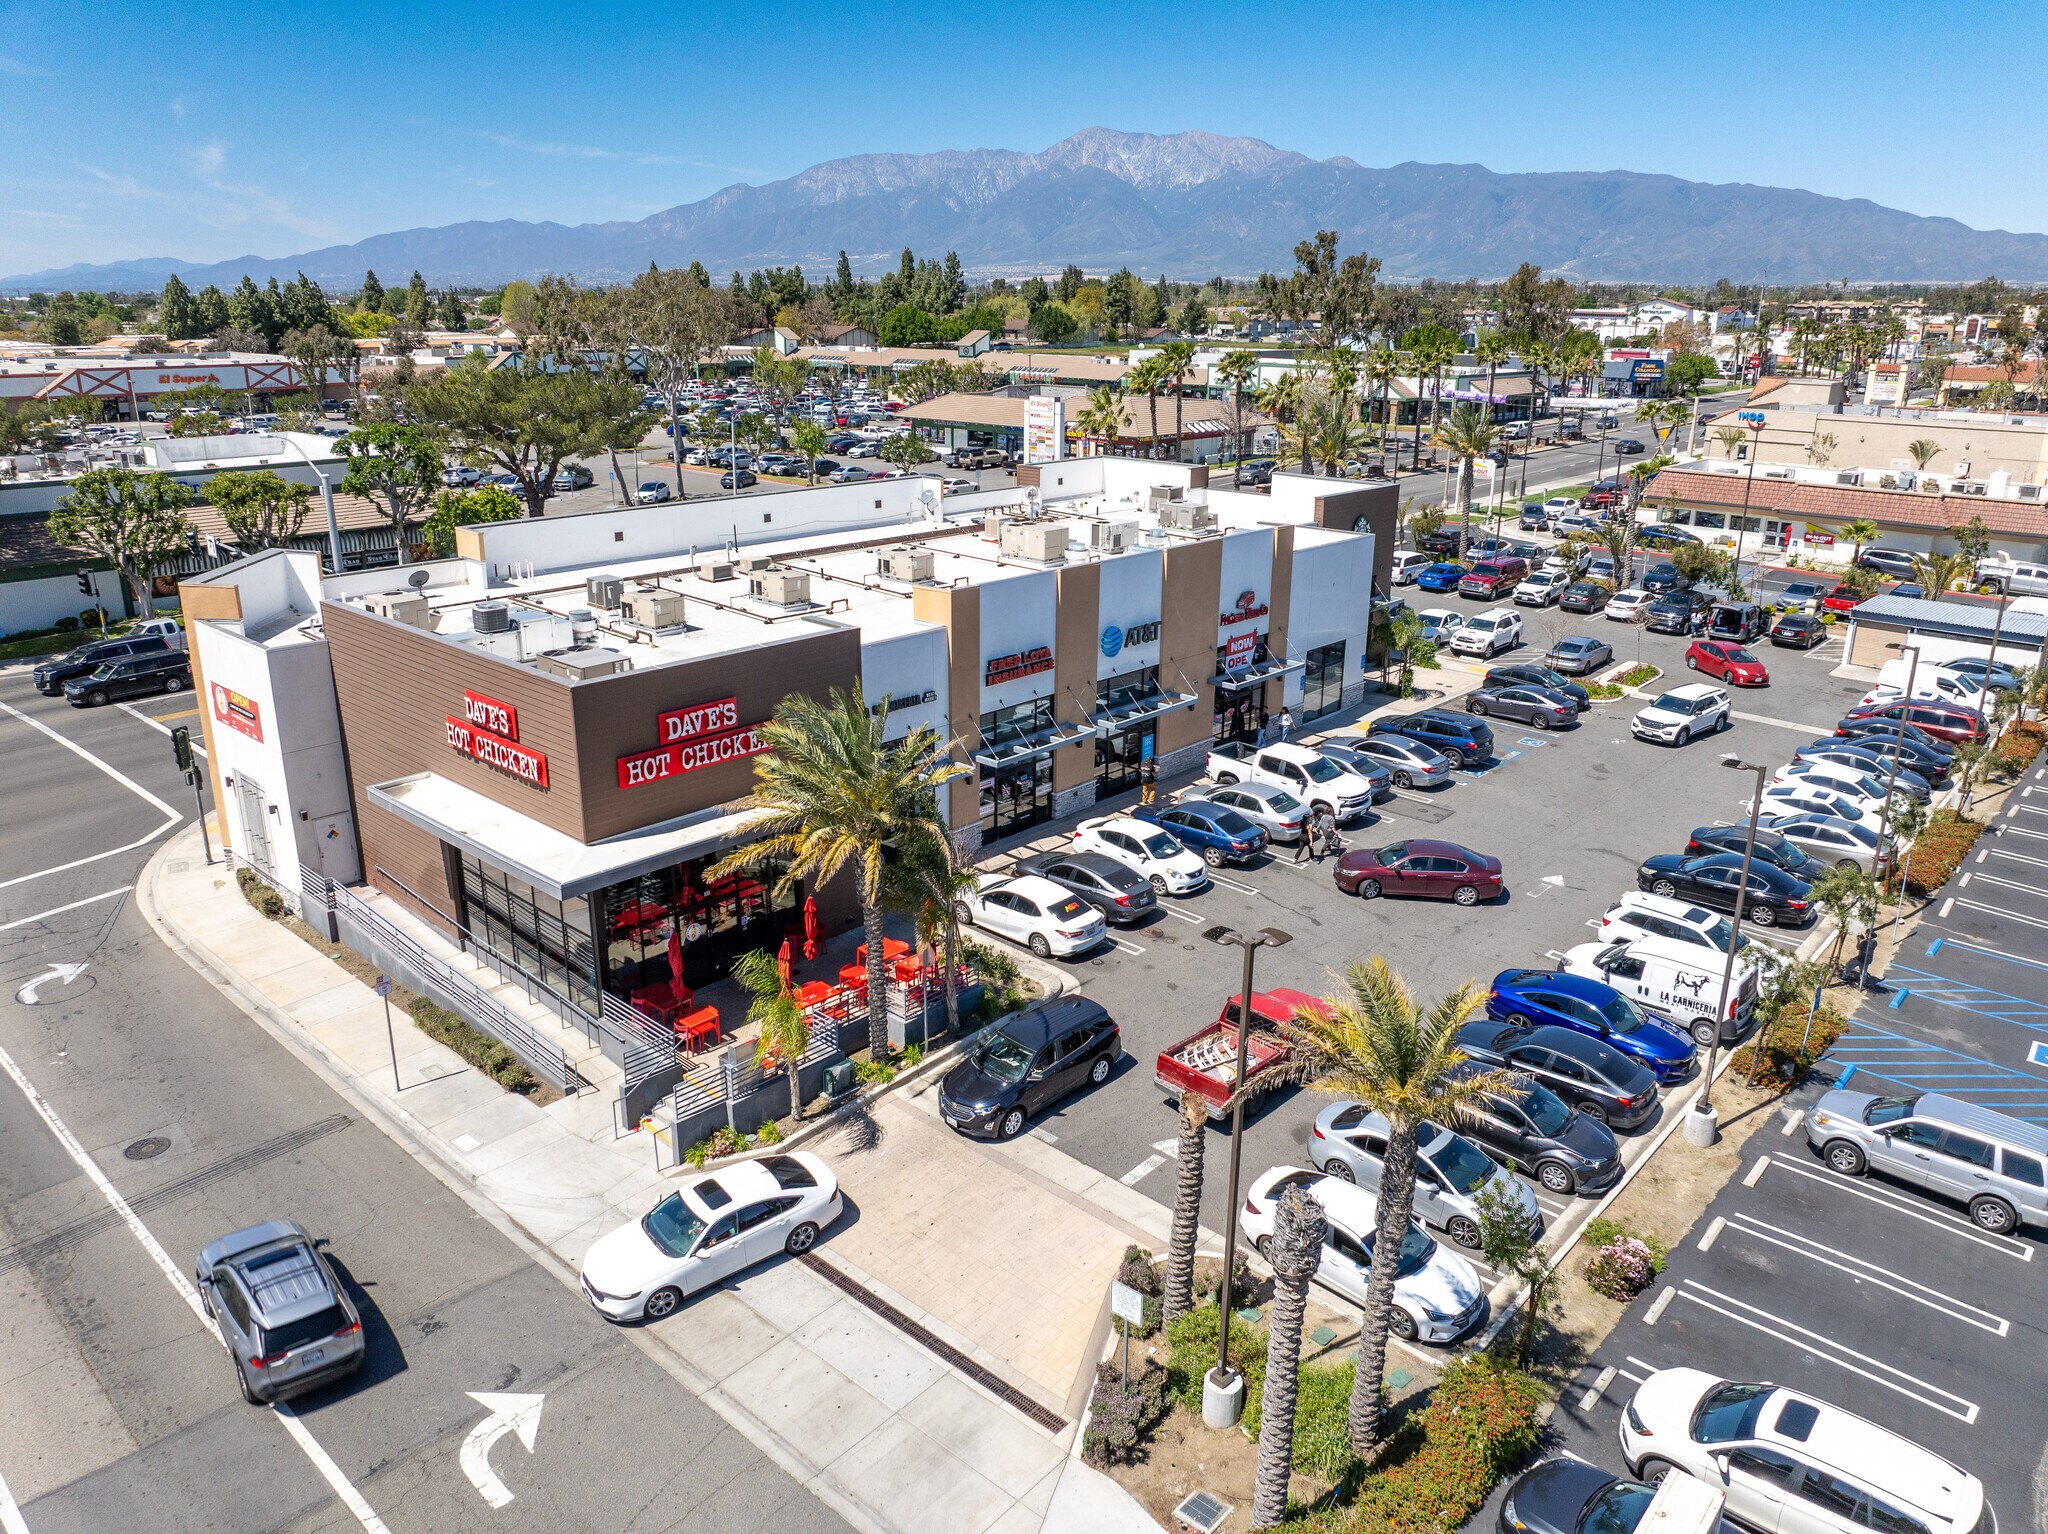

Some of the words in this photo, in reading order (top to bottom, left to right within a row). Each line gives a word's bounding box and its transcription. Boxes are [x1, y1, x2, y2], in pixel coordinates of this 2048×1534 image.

[158, 374, 170, 384] El
[173, 374, 207, 385] Super
[1805, 534, 1833, 542] IN-N-OUT
[1124, 621, 1162, 648] AT&T
[1230, 636, 1254, 653] NOW
[988, 655, 1021, 672] FRED
[1022, 647, 1052, 665] LOYA
[1227, 654, 1248, 669] OPE
[986, 659, 1055, 687] INSURANCE
[230, 691, 251, 710] OPEN!
[464, 696, 509, 734] DAVE'S
[666, 702, 737, 740] DAVE'S
[445, 722, 471, 752] HOT
[476, 736, 539, 782] CHICKEN
[627, 753, 671, 785] HOT
[1660, 991, 1670, 1001] LA
[1672, 994, 1717, 1016] CARNICERIA
[1660, 999, 1680, 1008] MEAT
[1684, 1006, 1717, 1019] MARKET
